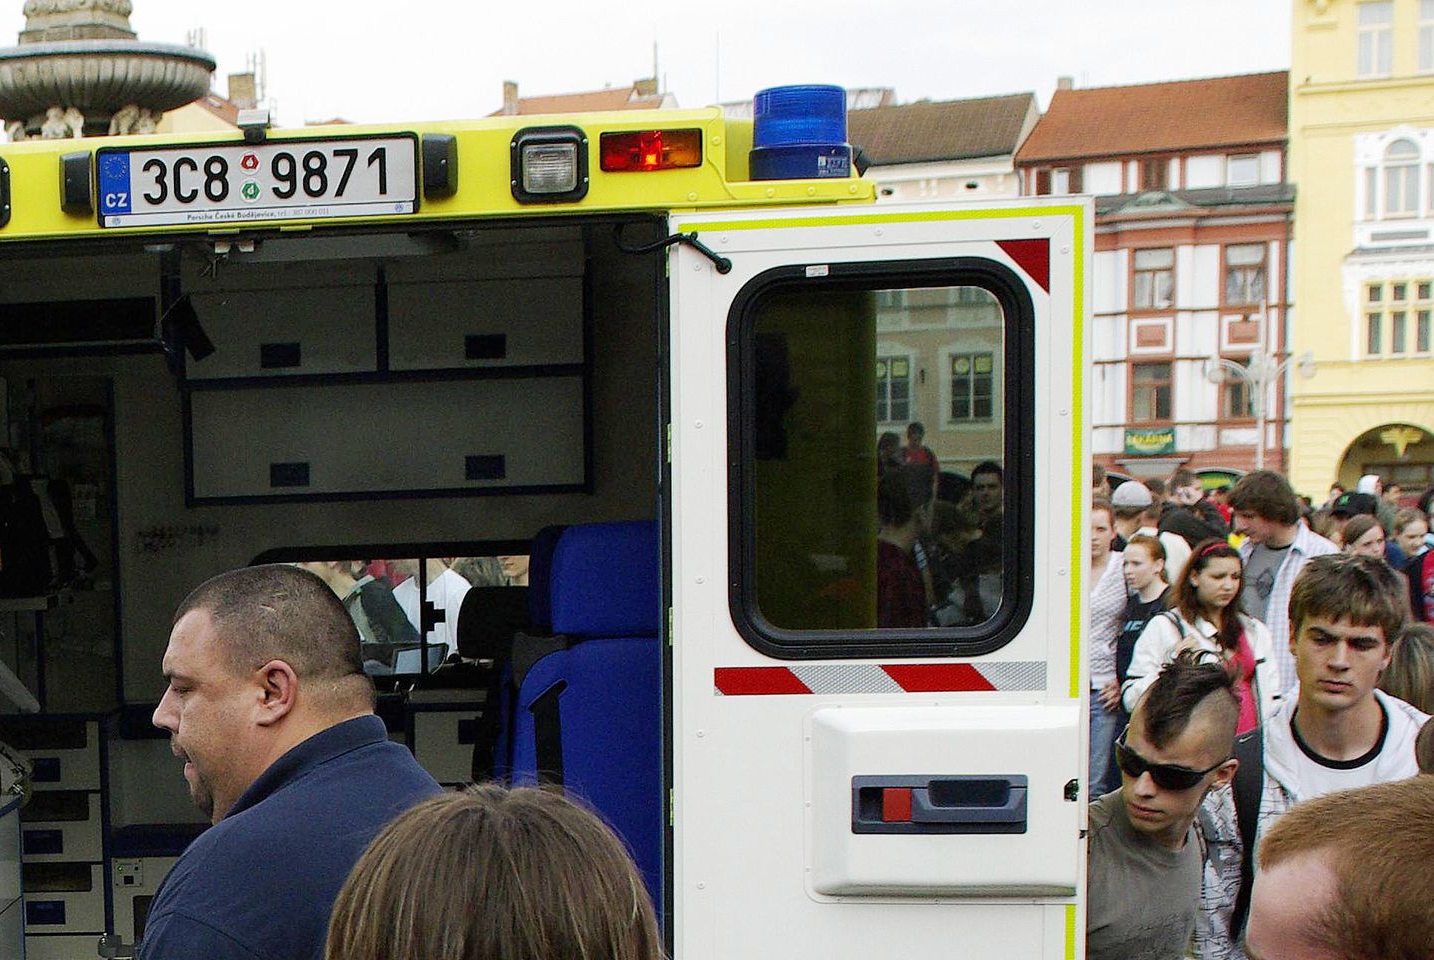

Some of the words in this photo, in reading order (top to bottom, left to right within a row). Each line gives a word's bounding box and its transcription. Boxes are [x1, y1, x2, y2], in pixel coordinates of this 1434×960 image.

[142, 155, 230, 206] 3C8
[271, 147, 387, 199] 9871
[105, 193, 127, 208] CZ
[215, 211, 235, 219] České
